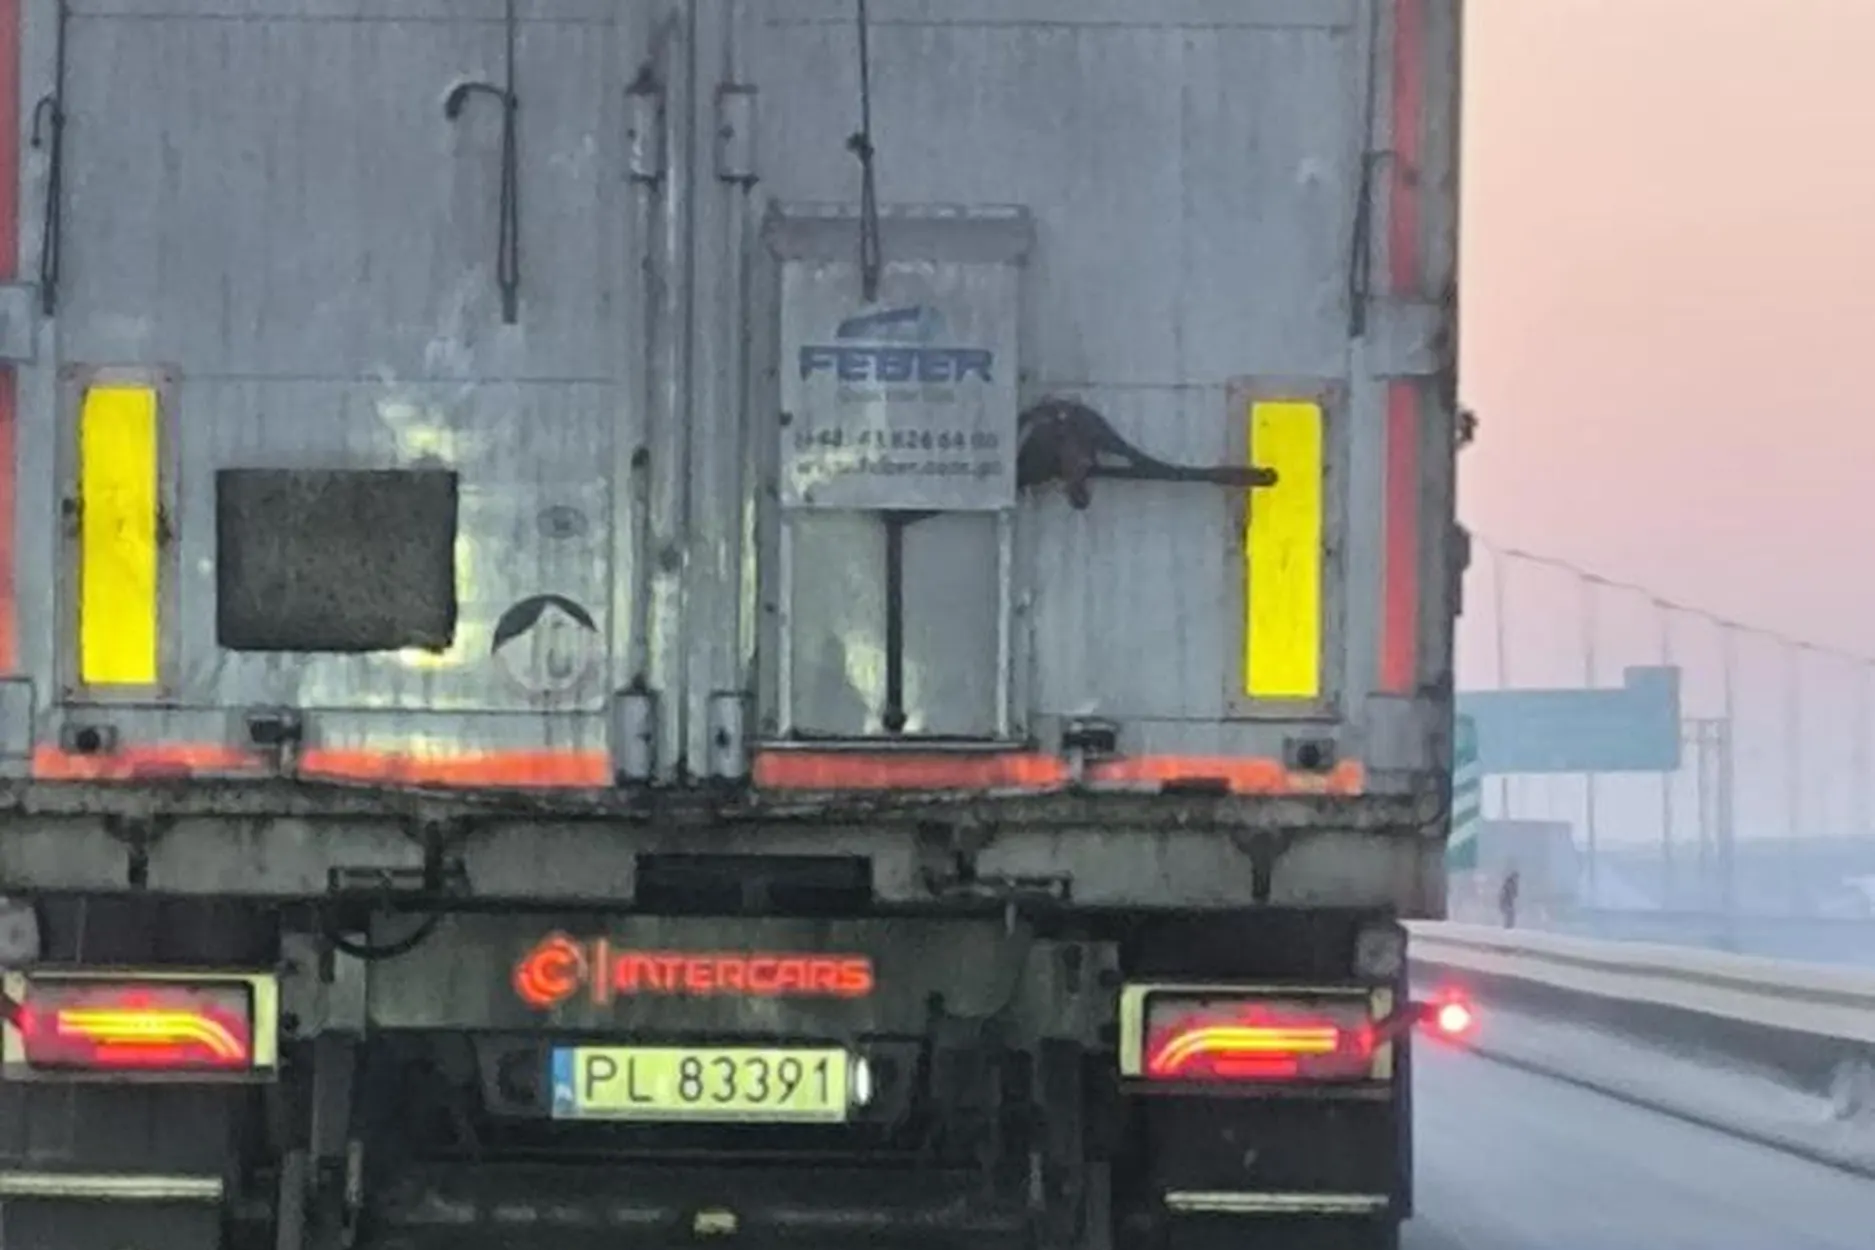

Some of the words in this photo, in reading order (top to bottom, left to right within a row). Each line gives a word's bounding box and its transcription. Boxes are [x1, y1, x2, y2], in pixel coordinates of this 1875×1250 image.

[799, 345, 994, 383] FEBER
[584, 1056, 654, 1101] PL
[678, 1056, 830, 1103] 83391
